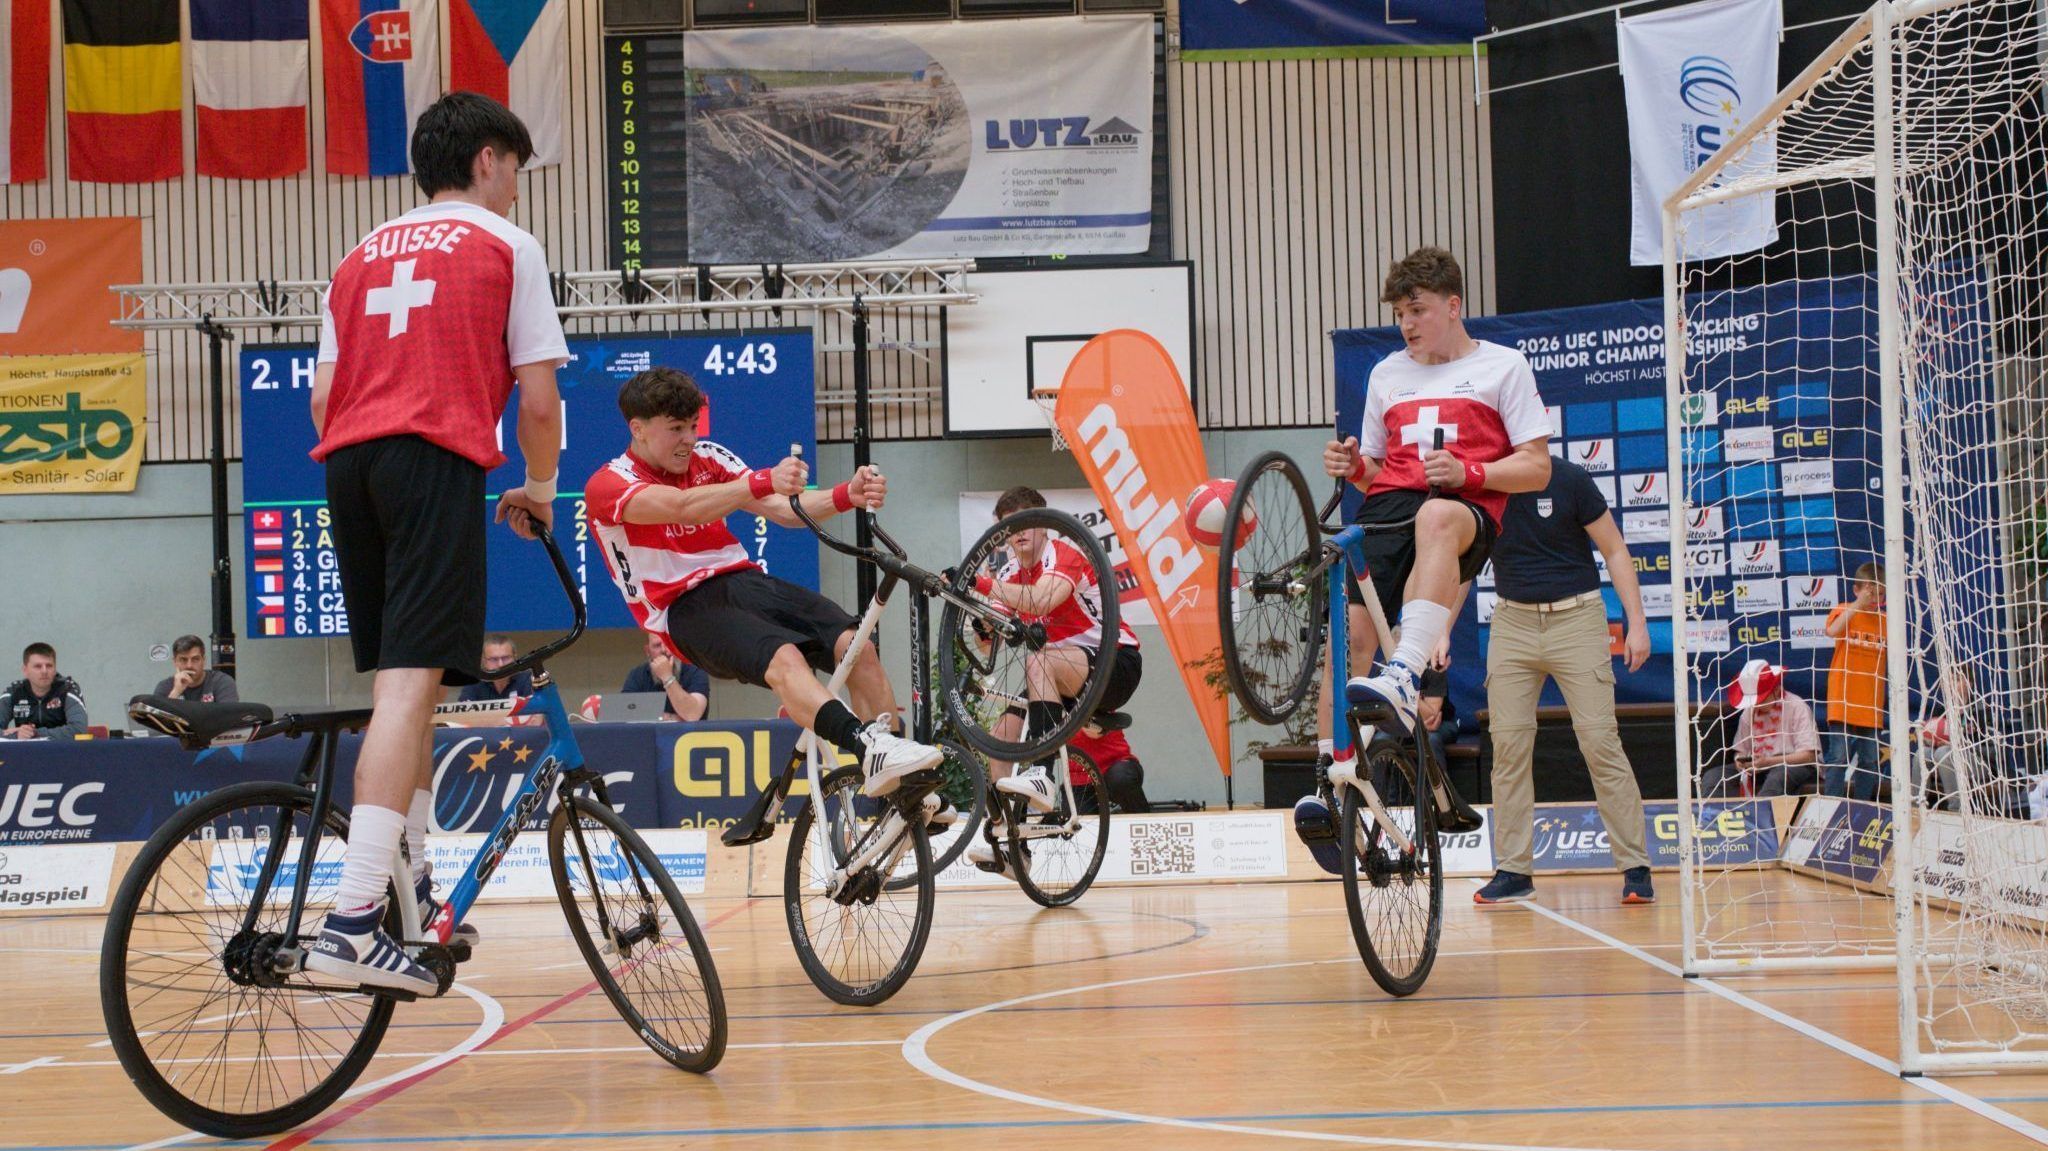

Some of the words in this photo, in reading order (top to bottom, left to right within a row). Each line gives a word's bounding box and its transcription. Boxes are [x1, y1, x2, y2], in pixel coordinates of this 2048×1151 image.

[621, 40, 633, 55] 4
[622, 60, 634, 75] 5
[622, 80, 634, 95] 6
[623, 100, 634, 115] 7
[623, 120, 635, 135] 8
[986, 116, 1091, 149] LUTZ
[1099, 134, 1133, 145] BAU
[624, 140, 636, 155] 9
[620, 160, 640, 175] 10
[1012, 166, 1118, 177] Grundwasserabsenkungen
[621, 180, 640, 194] 11
[1012, 178, 1034, 187] Hoch-
[1038, 178, 1053, 186] und
[1056, 177, 1085, 186] Tiefbau
[1012, 188, 1059, 197] Straßenbau
[621, 199, 640, 214] 12
[622, 219, 640, 234] 13
[1002, 217, 1077, 228] www.lutzbau.com
[363, 223, 471, 263] SUISSE
[622, 239, 641, 254] 14
[1516, 338, 1560, 356] 2026
[1565, 331, 1597, 350] UEC
[1602, 325, 1665, 346] INDOO
[1684, 315, 1760, 338] CYCLING
[704, 343, 778, 376] 4:43
[1529, 352, 1590, 372] JUNIOR
[1595, 334, 1748, 366] CHAMPINSHIPS
[9, 370, 49, 379] Höchst,
[54, 367, 117, 378] Hauptstraße
[119, 366, 132, 376] 43
[251, 358, 279, 390] 2.
[291, 357, 315, 389] H
[1585, 369, 1630, 385] HÖCHST
[1639, 366, 1666, 379] AUST
[0, 395, 64, 408] TIONEN
[0, 392, 134, 464] esto
[1581, 461, 1608, 471] ttoria
[12, 470, 70, 484] Sanitär
[84, 469, 125, 483] Solar
[1629, 495, 1662, 505] vittoria
[292, 508, 310, 528] 1.
[316, 508, 331, 528] S
[292, 530, 310, 549] 2.
[316, 529, 334, 548] A
[755, 516, 767, 535] 3
[293, 551, 311, 571] 3.
[317, 550, 338, 570] G
[755, 538, 767, 556] 7
[1738, 562, 1774, 573] vittoria
[293, 572, 311, 591] 4.
[318, 572, 341, 591] FR
[294, 594, 312, 613] 5.
[318, 593, 346, 612] CZ
[294, 615, 313, 634] 6.
[320, 613, 350, 633] BE
[11, 828, 93, 841] EUROPÉENNE
[1556, 831, 1612, 849] UEC
[435, 846, 452, 856] Ihr
[526, 844, 541, 855] im
[435, 859, 456, 870] dem
[658, 857, 705, 865] WANEN
[667, 867, 705, 876] ÖCHST
[938, 869, 976, 880] GMBH
